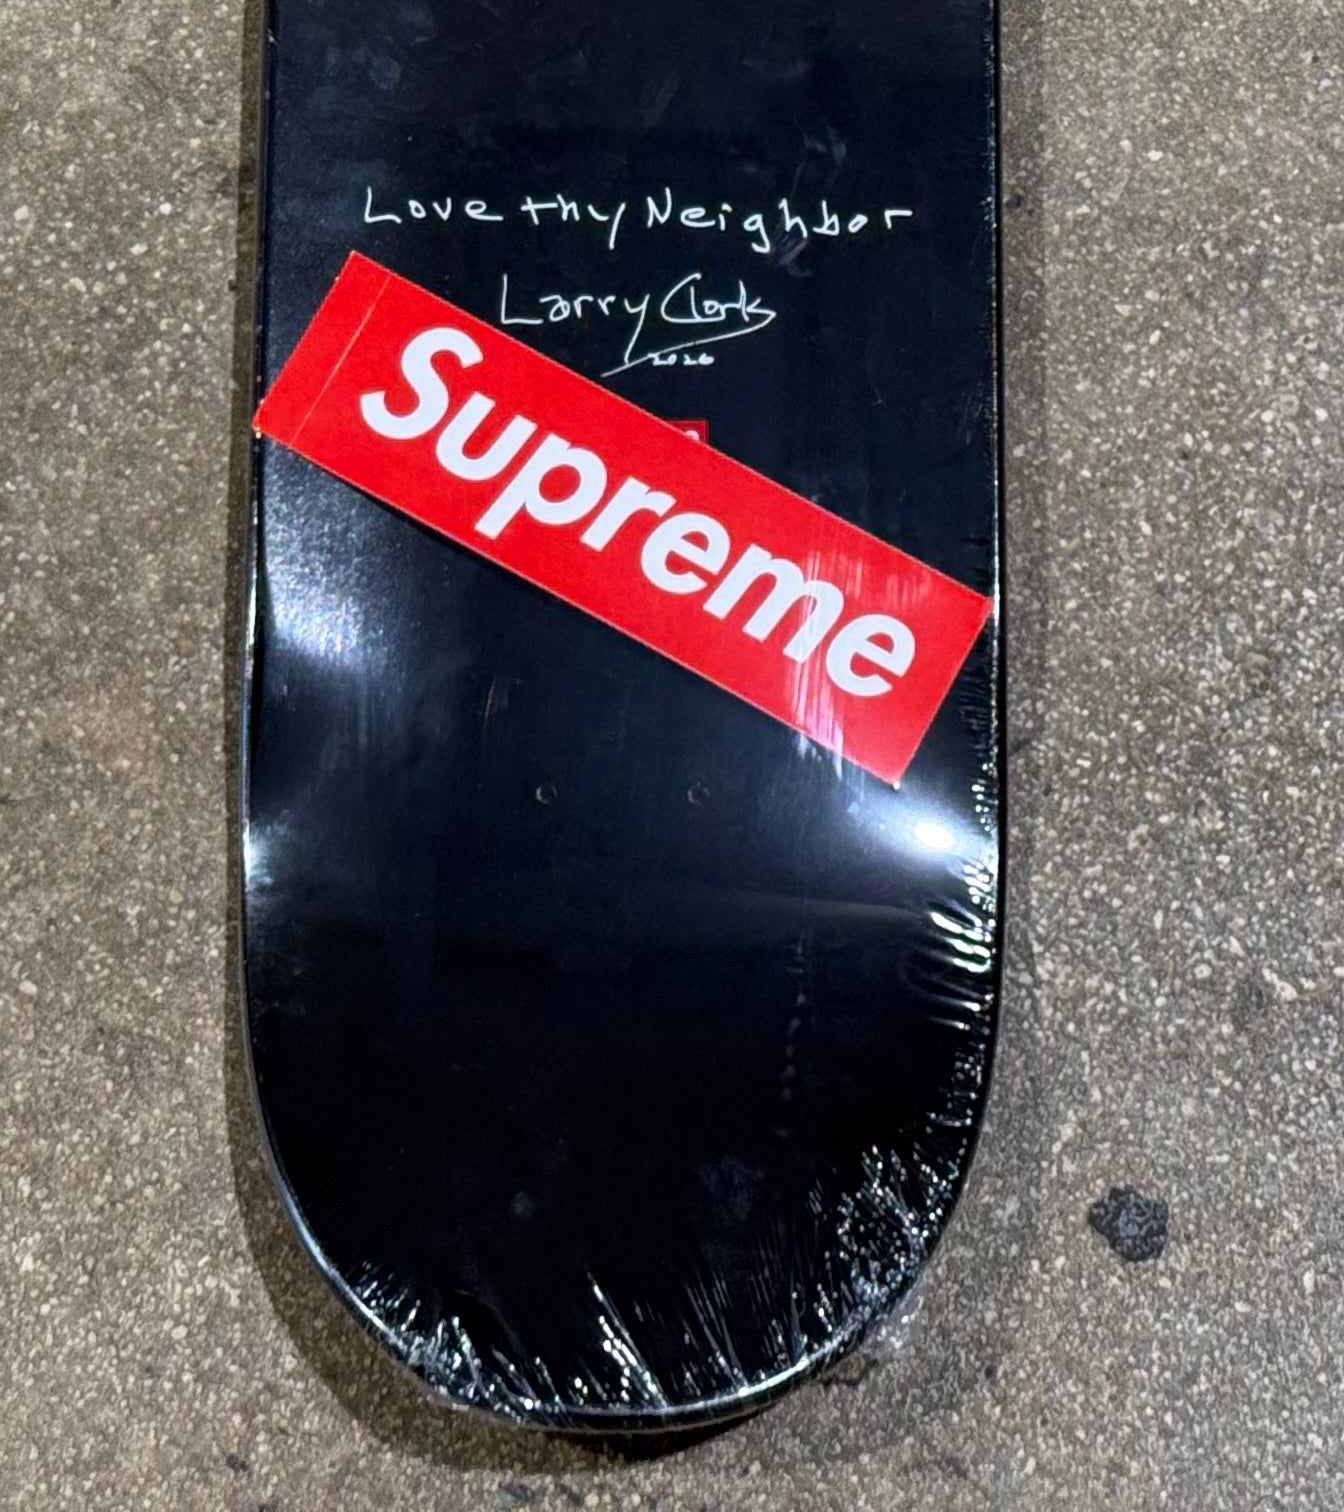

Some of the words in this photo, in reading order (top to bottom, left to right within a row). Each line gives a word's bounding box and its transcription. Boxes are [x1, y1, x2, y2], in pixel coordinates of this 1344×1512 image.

[364, 187, 503, 226] Love
[520, 191, 629, 249] thy
[646, 187, 913, 252] Neighbor
[499, 273, 651, 364] Larry
[359, 327, 917, 696] Supreme
